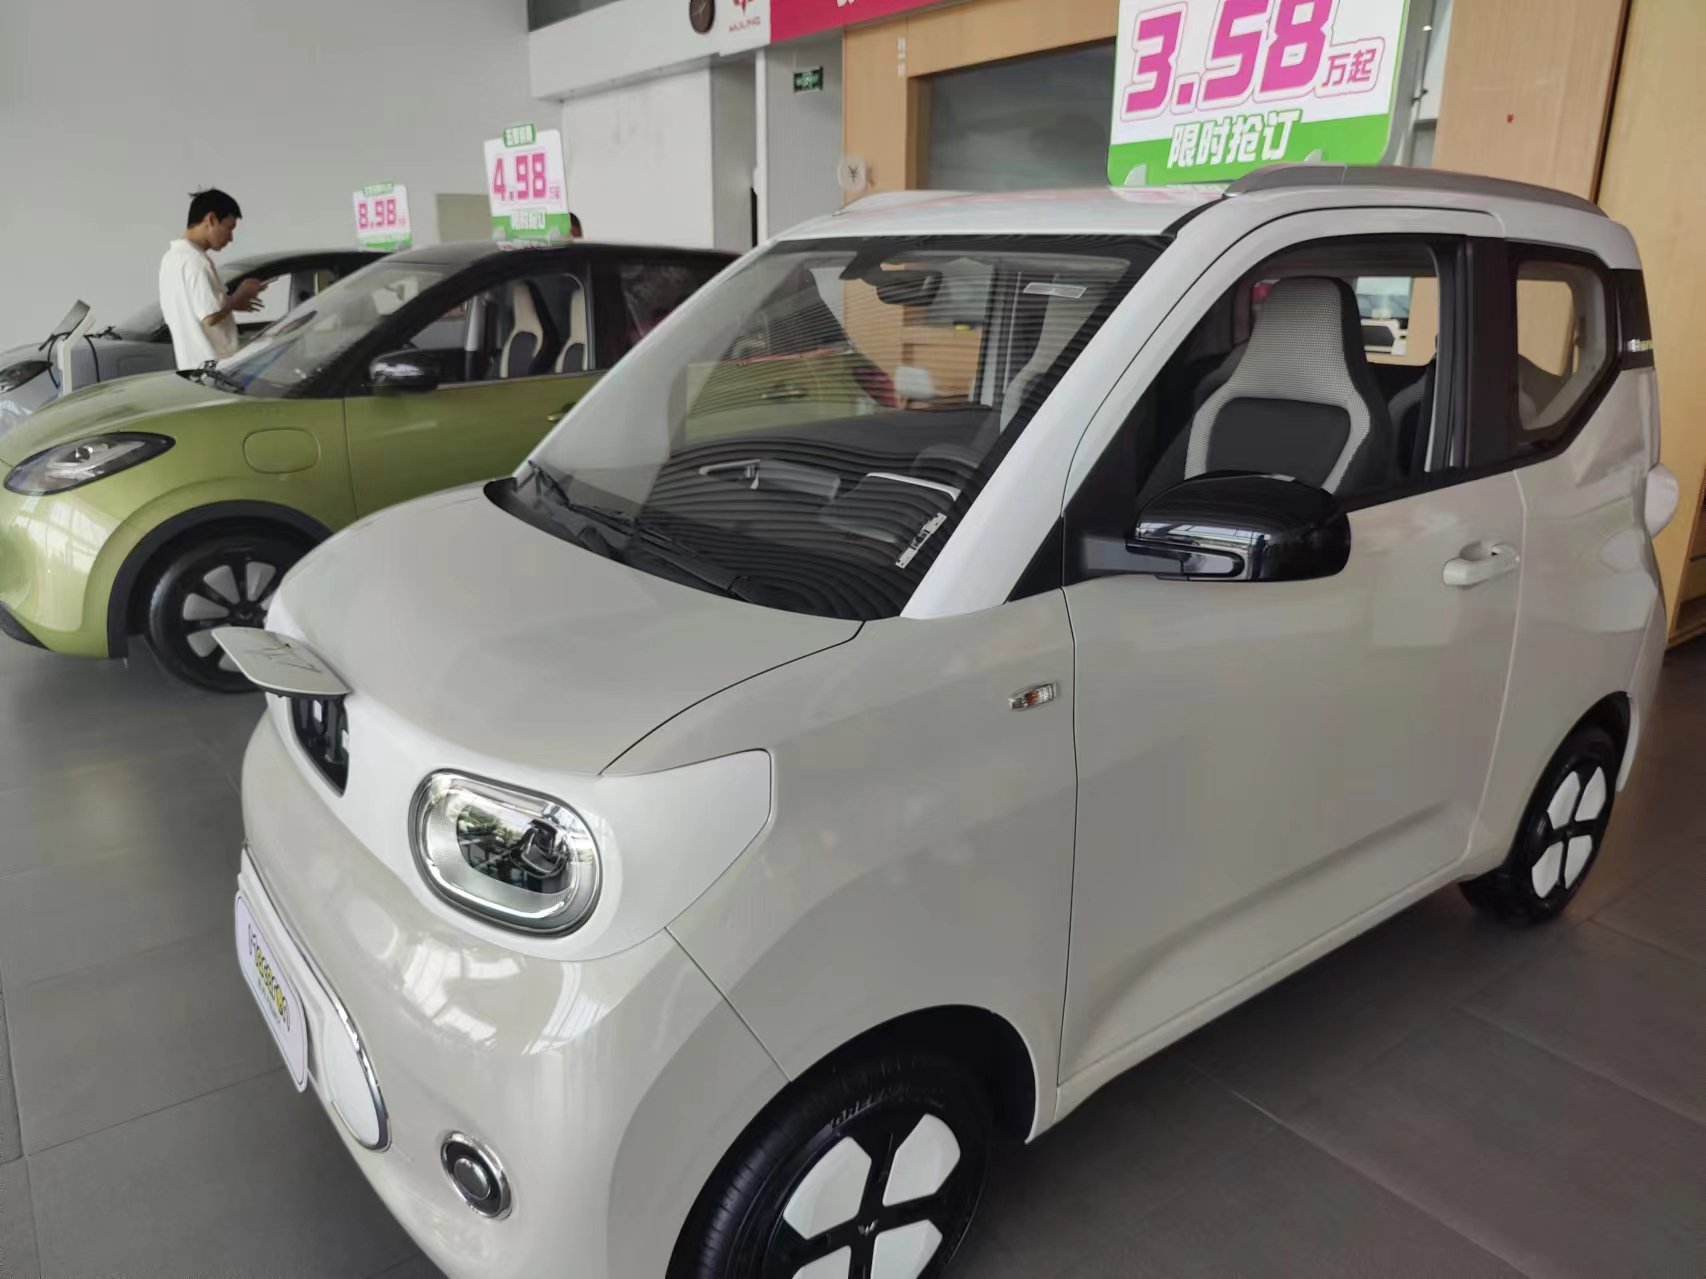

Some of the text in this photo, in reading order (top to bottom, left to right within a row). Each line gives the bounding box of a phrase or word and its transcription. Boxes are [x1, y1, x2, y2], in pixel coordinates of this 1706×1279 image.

[1124, 0, 1378, 114] 3.58 万起
[1166, 109, 1304, 169] 限时抢订
[493, 152, 547, 202] 4.98
